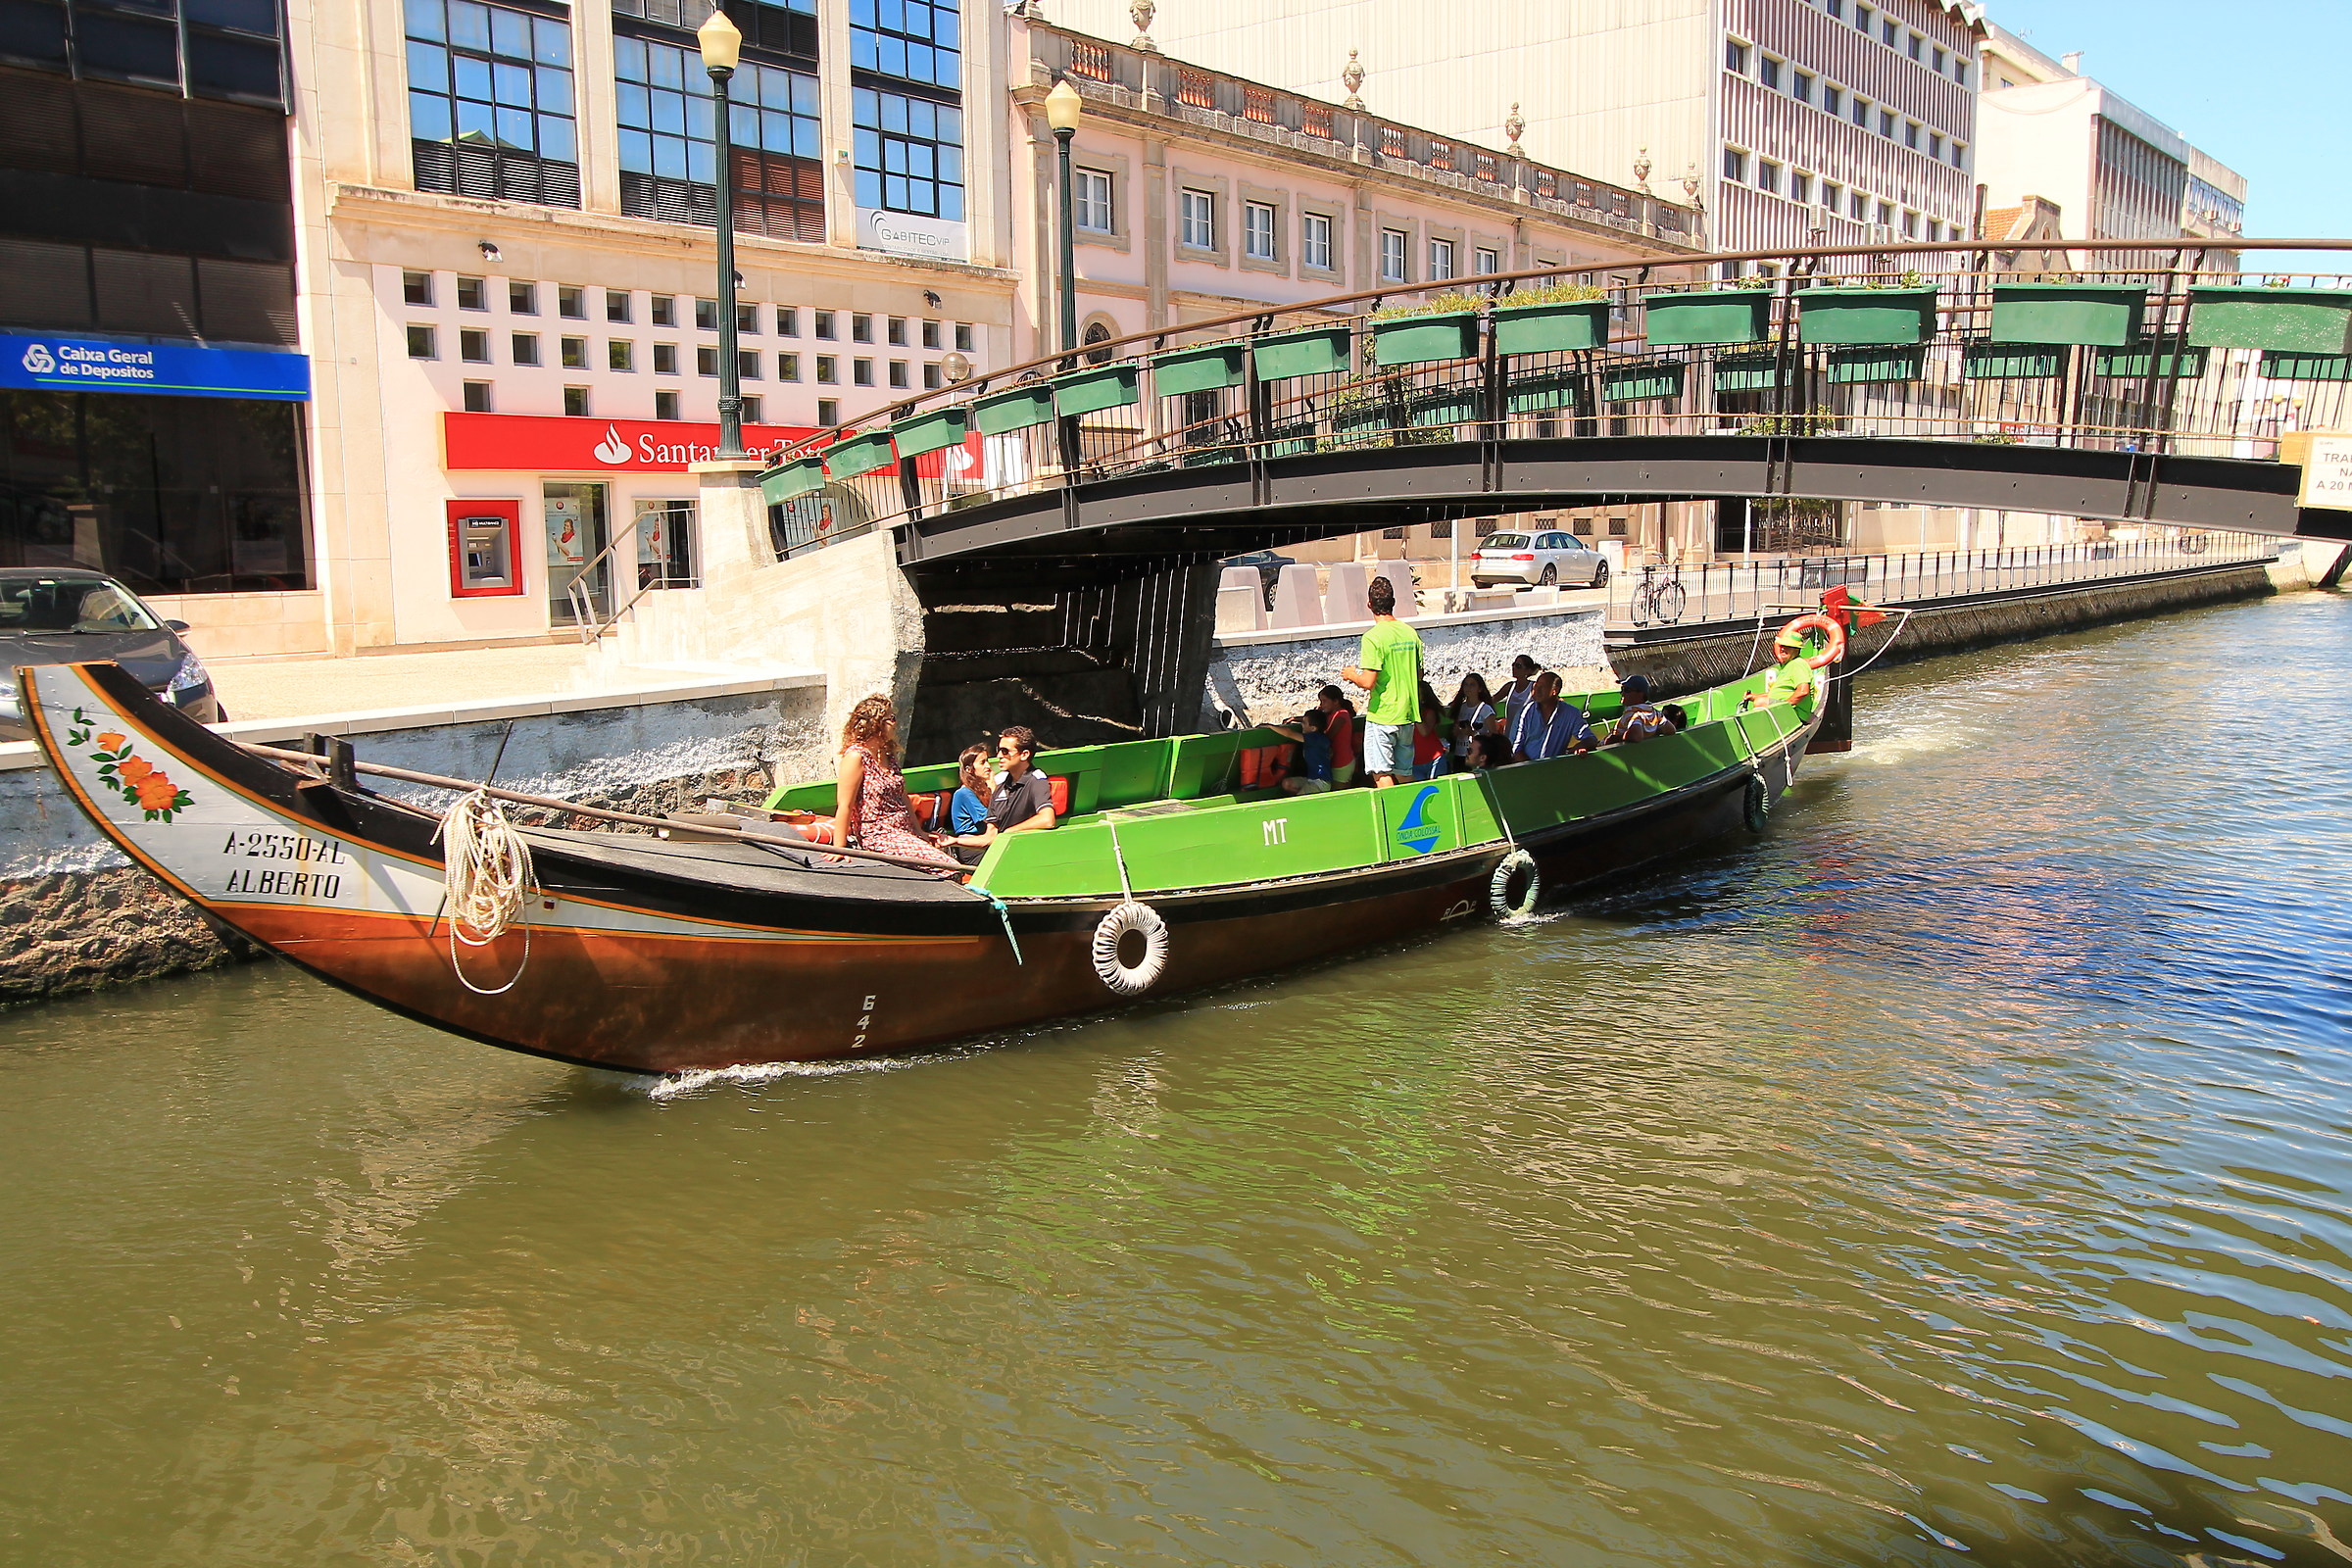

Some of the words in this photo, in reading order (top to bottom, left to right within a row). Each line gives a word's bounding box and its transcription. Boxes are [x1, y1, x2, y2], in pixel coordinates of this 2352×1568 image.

[58, 346, 106, 362] Caixa
[108, 349, 153, 365] Geral
[60, 362, 78, 375] de
[639, 433, 770, 464] Santaer
[773, 438, 822, 465] Tott
[2329, 480, 2344, 491] 20
[1261, 817, 1288, 846] MT
[1396, 830, 1413, 842] ONDA
[1413, 825, 1442, 838] COLOSSAL
[222, 830, 346, 864] A-2550-AL
[225, 868, 340, 899] ALBERTO
